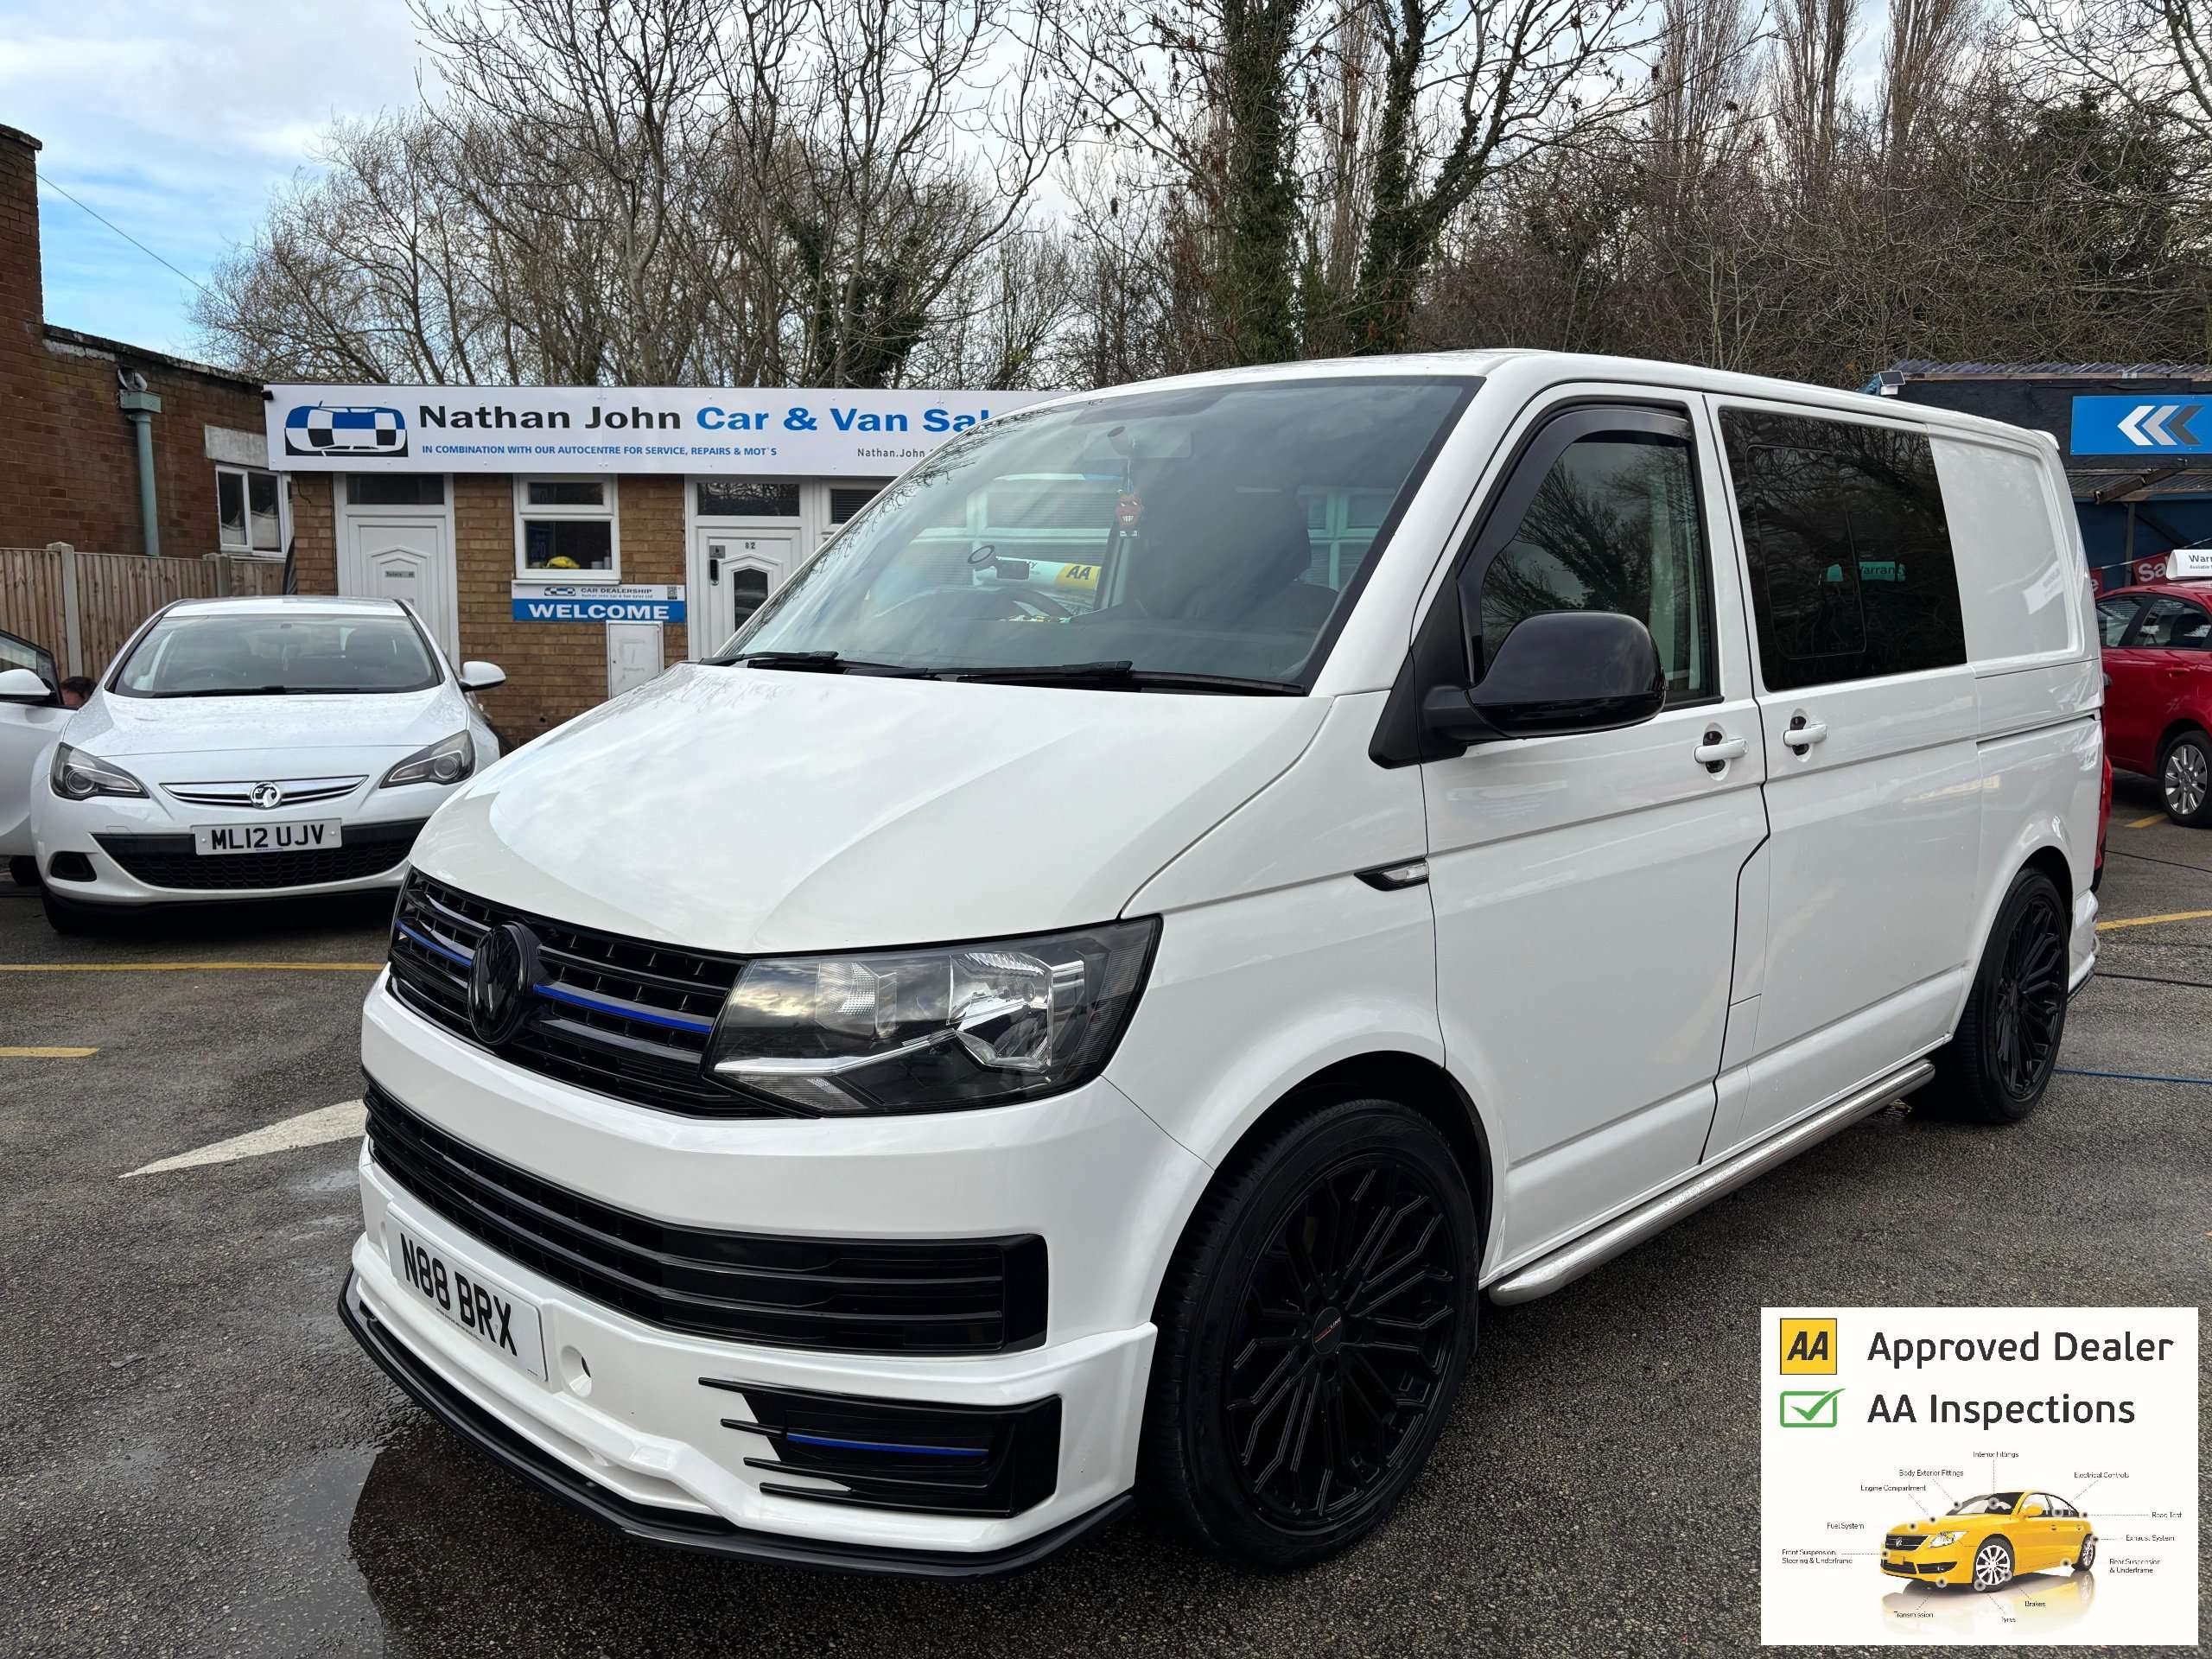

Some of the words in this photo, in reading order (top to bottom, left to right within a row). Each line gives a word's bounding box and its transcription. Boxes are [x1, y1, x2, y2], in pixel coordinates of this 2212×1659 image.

[419, 405, 570, 429] Nathan
[585, 405, 681, 429] John
[696, 406, 770, 430] Car
[783, 407, 818, 431] &
[830, 408, 908, 432] Van
[422, 445, 433, 454] IN
[435, 445, 505, 454] COMBINATION
[507, 445, 531, 454] WITH
[534, 446, 556, 454] OUR
[558, 446, 620, 455] AUTOCENTRE
[624, 447, 642, 455] FOR
[645, 447, 688, 456] SERVICE,
[691, 447, 731, 455] REPAIRS
[857, 448, 925, 458] Nathan.John
[745, 541, 756, 550] 82
[1065, 565, 1092, 580] AA
[529, 604, 670, 620] WELCOME
[212, 828, 269, 849] ML12
[276, 824, 324, 847] UJV
[400, 1233, 451, 1311] N88
[454, 1271, 518, 1357] BRX
